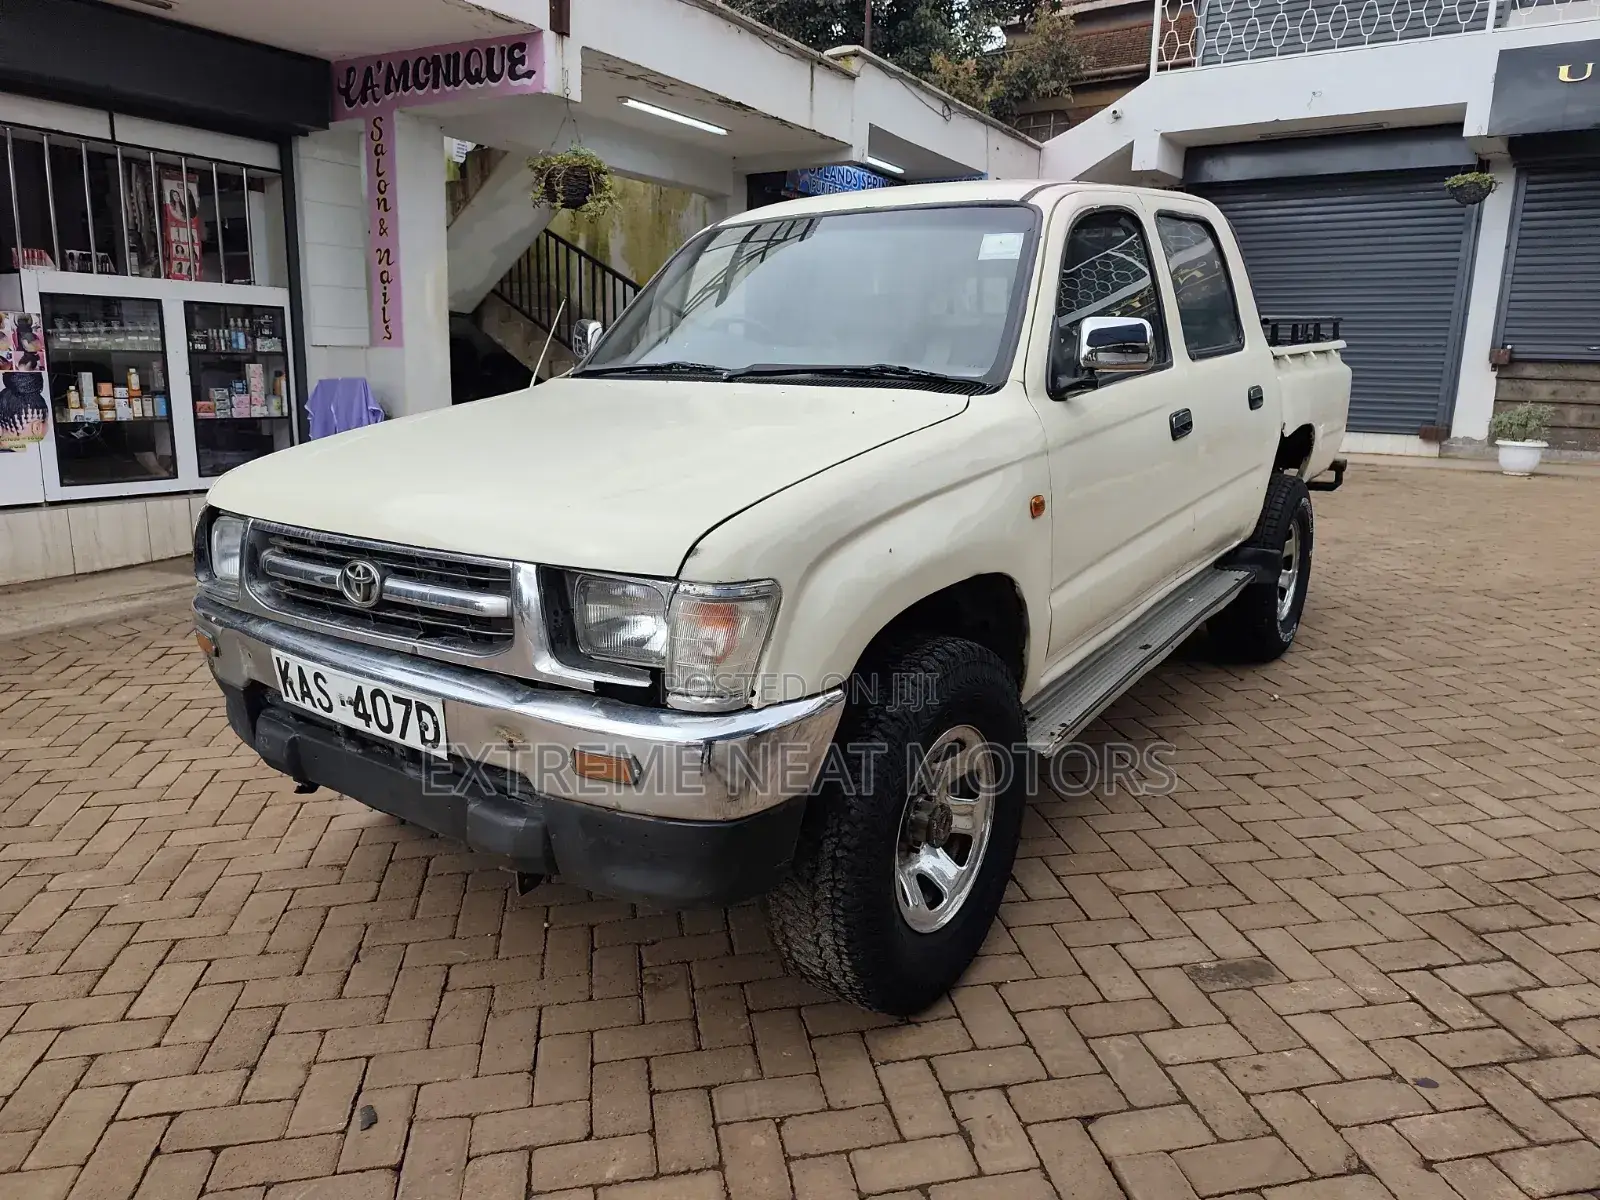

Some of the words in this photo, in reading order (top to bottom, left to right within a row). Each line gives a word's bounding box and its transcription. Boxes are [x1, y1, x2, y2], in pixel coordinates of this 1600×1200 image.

[337, 42, 536, 109] LA'MONIQUE
[370, 116, 392, 213] Salon
[377, 217, 389, 237] &
[276, 656, 334, 714] KAS
[353, 685, 441, 749] 407D
